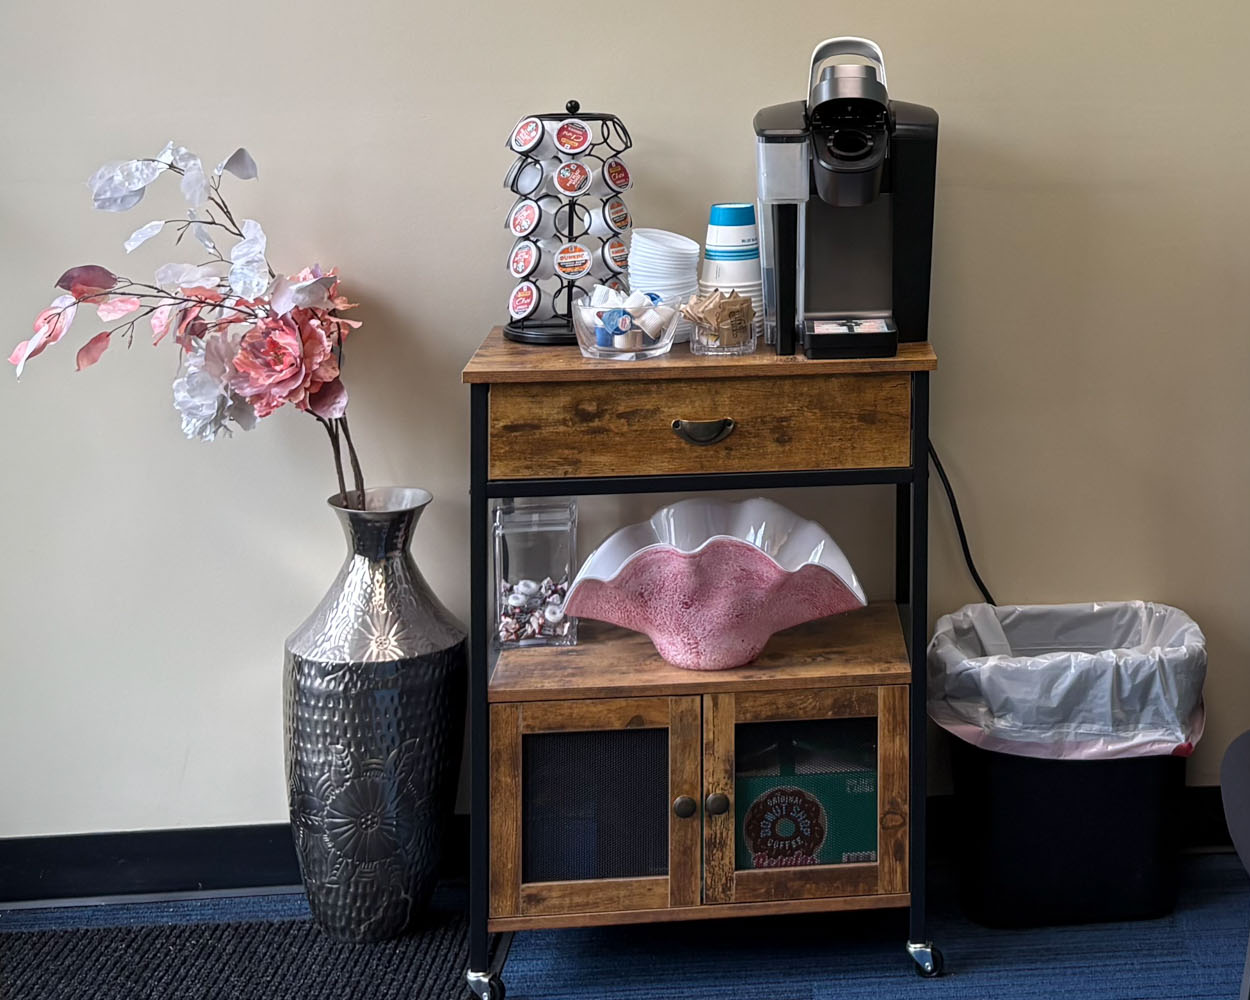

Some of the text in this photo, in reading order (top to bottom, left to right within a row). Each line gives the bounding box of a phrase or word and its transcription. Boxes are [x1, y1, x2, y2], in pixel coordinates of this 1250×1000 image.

[760, 803, 811, 838] DONUT SHOP
[767, 836, 805, 850] COFFEE
